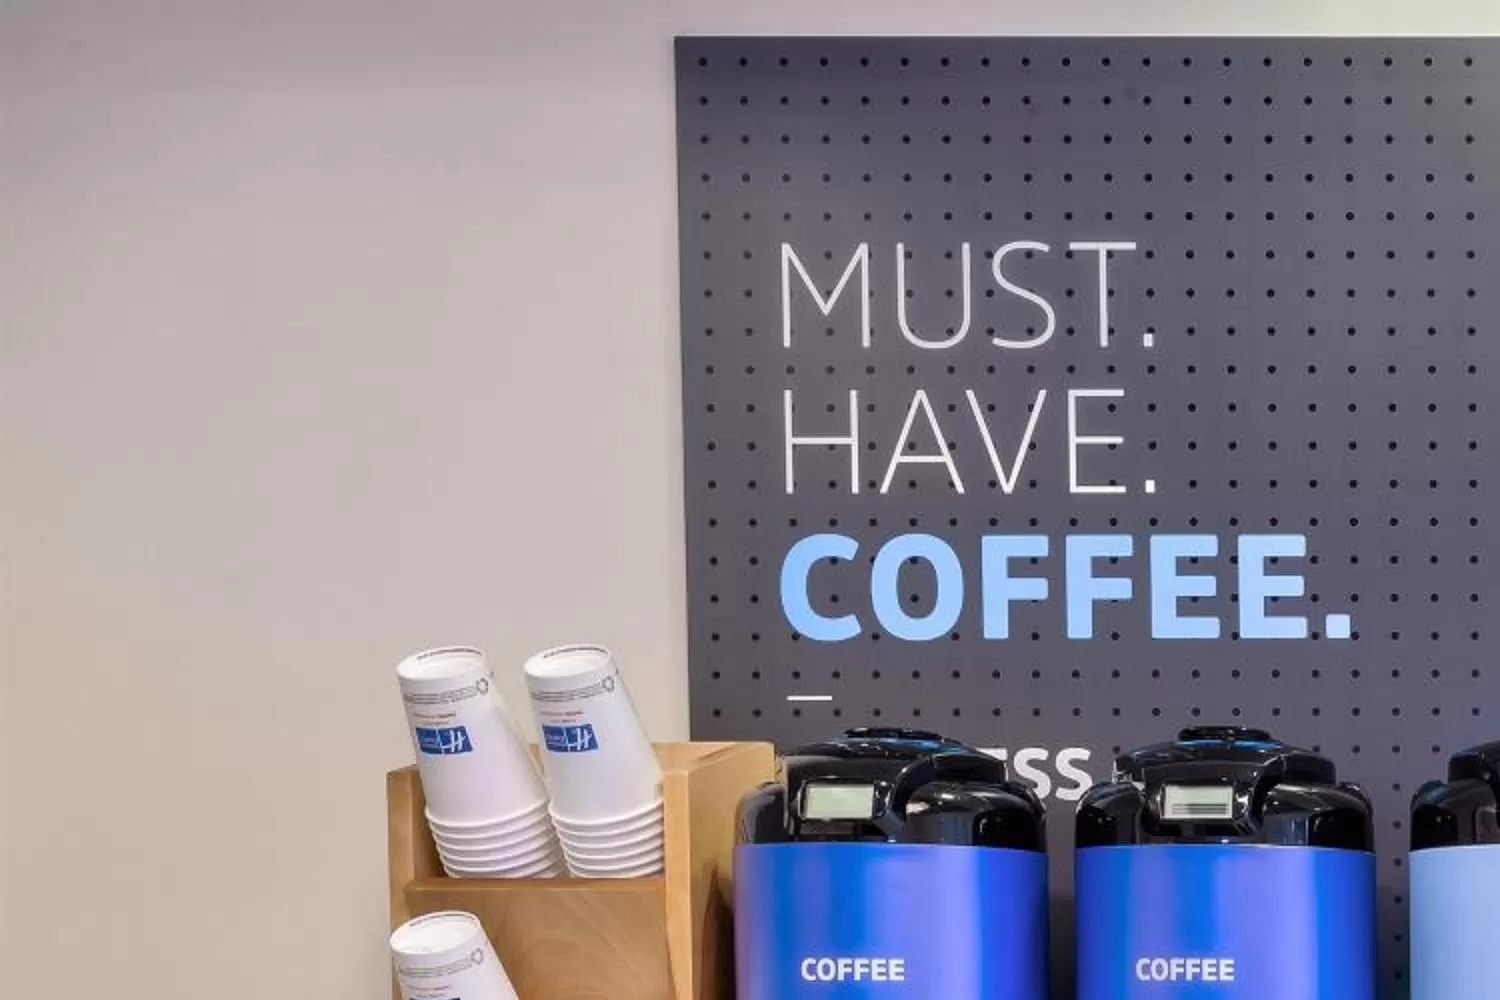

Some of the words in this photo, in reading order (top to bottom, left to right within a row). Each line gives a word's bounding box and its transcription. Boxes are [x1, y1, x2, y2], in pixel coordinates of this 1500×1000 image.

[780, 241, 1155, 349] MUST.
[783, 388, 1156, 494] HAVE.
[779, 532, 1351, 642] COFFEE.
[976, 746, 1094, 802] SS
[800, 957, 906, 982] COFFEE
[1135, 957, 1236, 982] COFFEE
